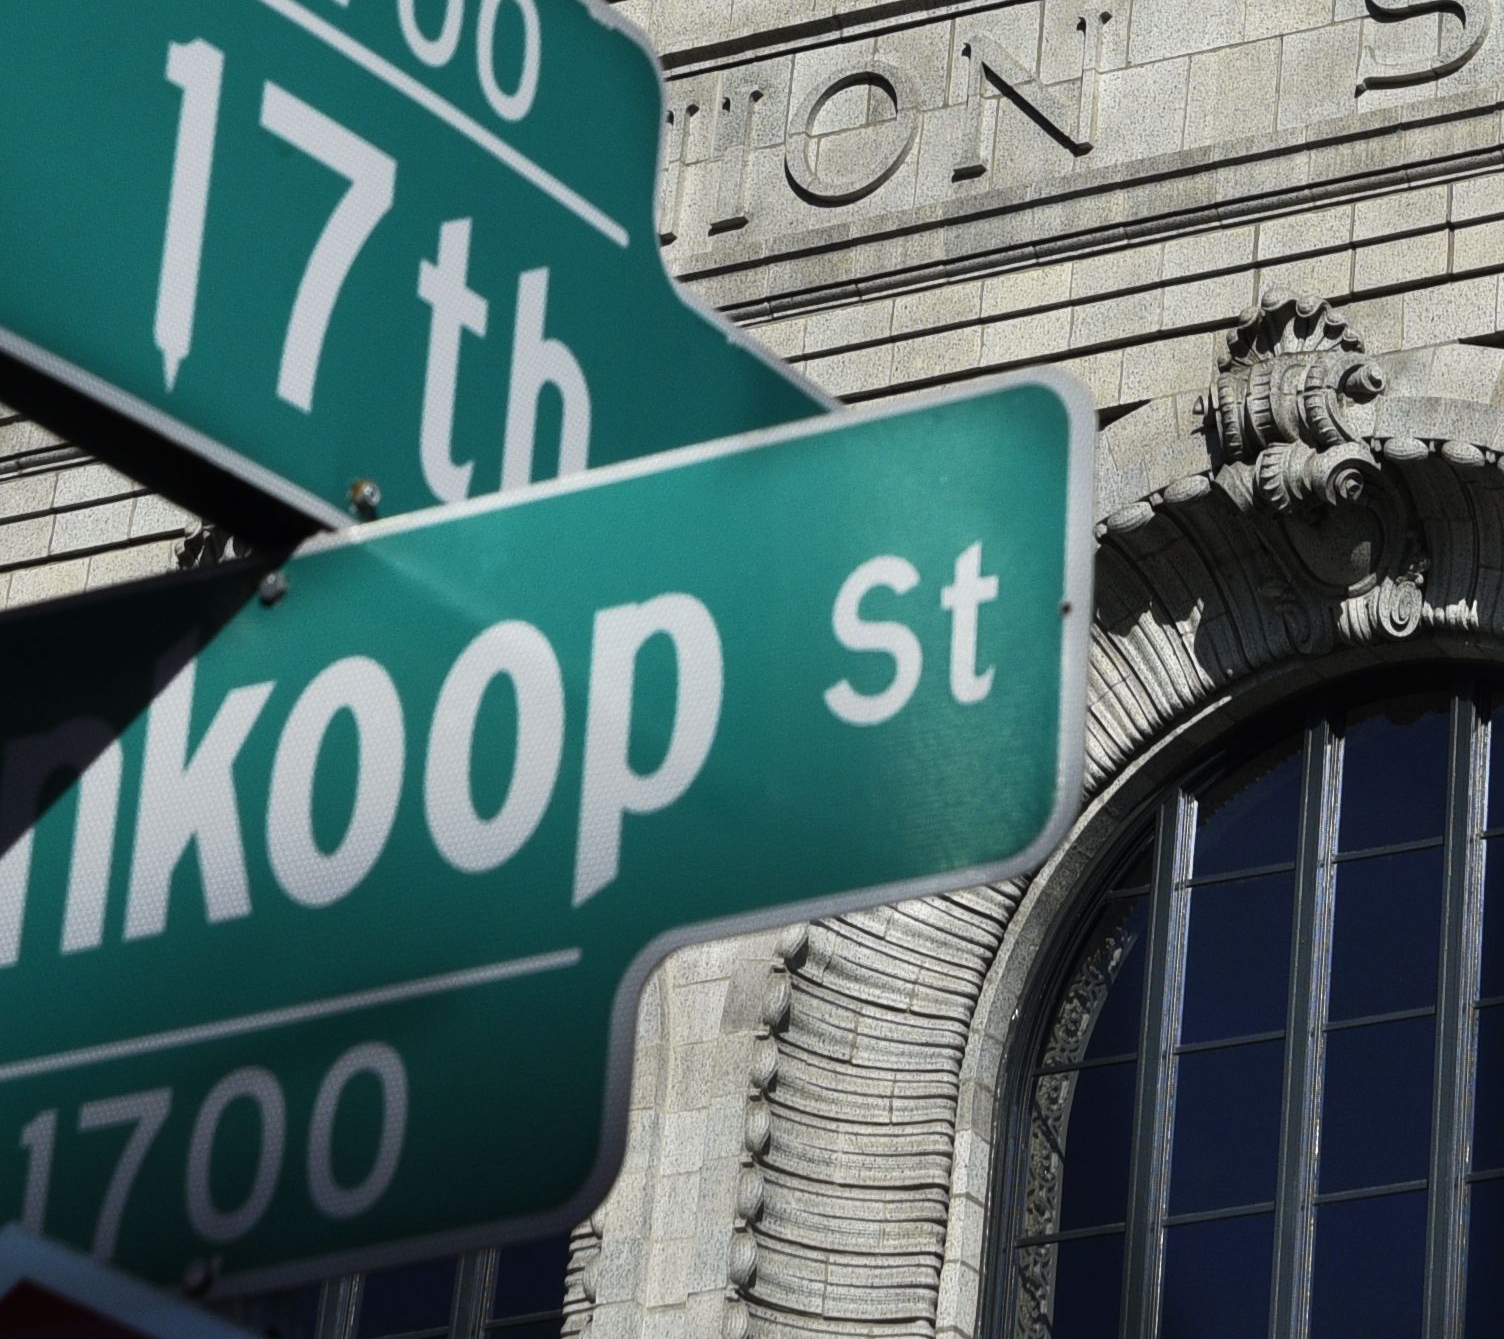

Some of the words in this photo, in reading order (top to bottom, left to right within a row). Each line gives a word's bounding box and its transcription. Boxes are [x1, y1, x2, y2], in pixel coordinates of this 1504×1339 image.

[659, 7, 1113, 248] ION
[153, 36, 593, 506] 17th
[822, 539, 1000, 727] St
[19, 1040, 410, 1263] 1700
